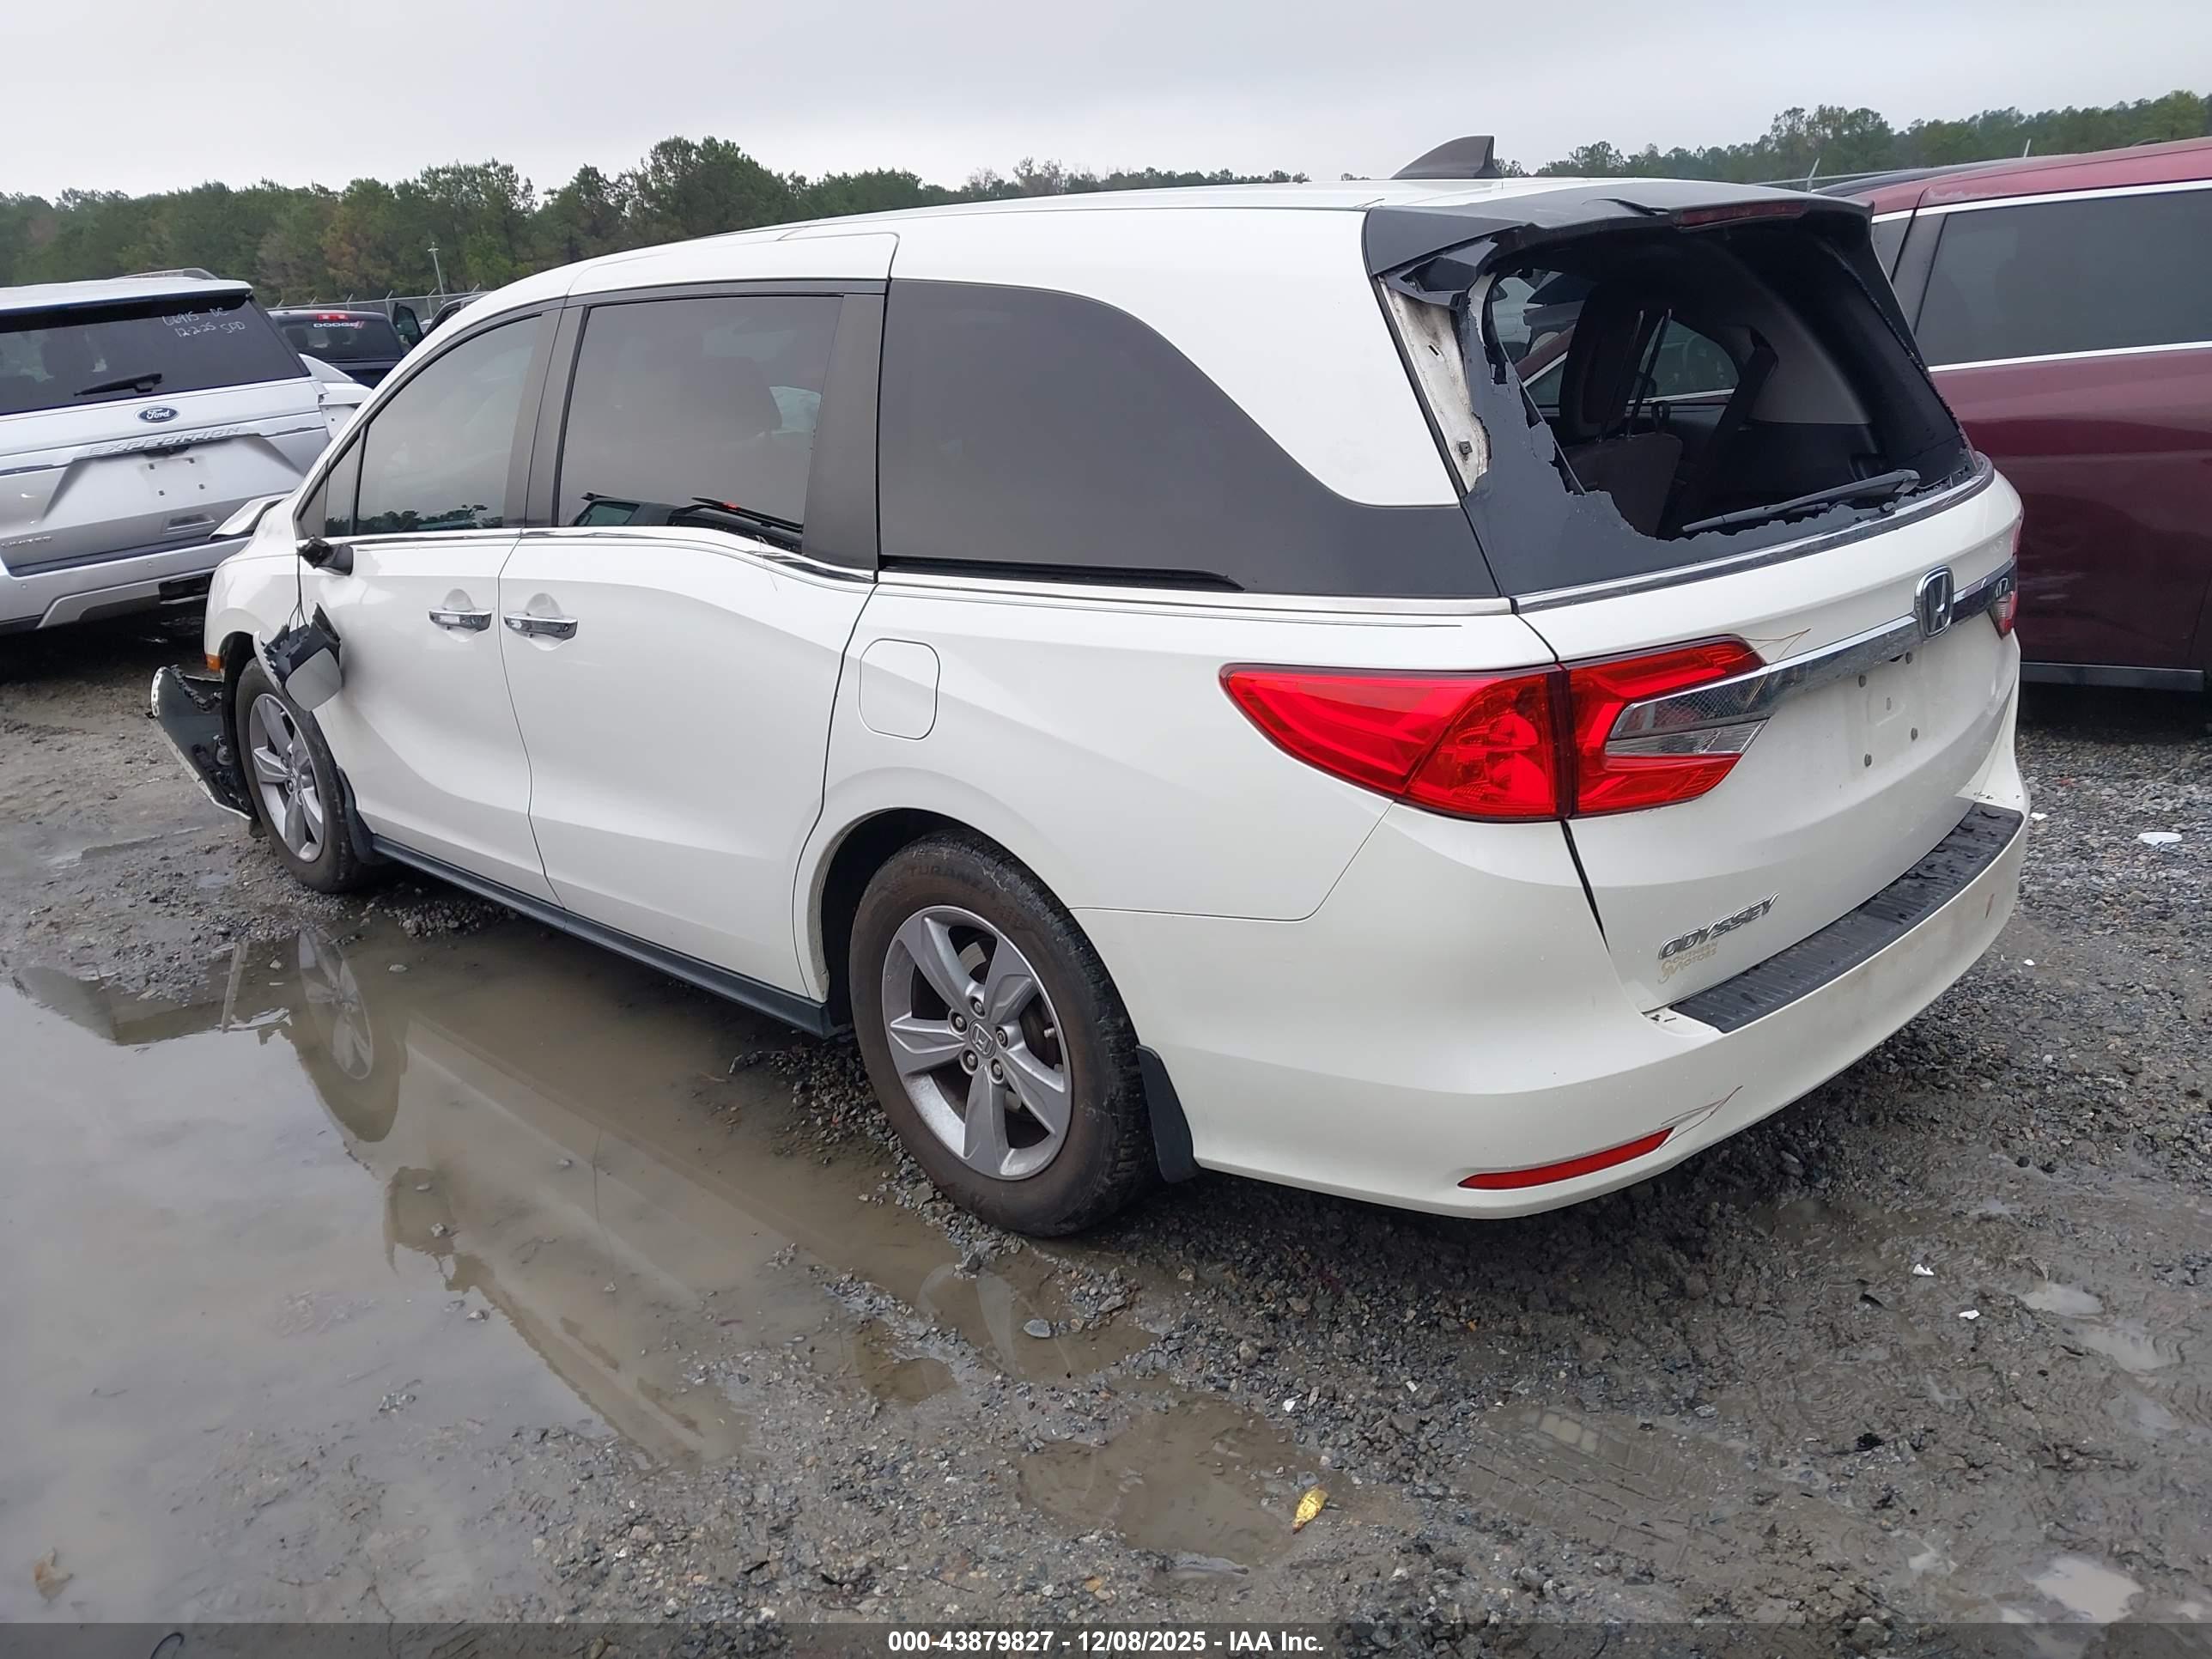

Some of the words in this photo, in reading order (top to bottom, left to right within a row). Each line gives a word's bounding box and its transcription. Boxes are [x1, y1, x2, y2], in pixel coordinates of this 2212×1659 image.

[146, 407, 171, 420] Ford
[88, 426, 241, 455] EXPEDITION
[1658, 892, 1780, 960] ODYSSEY
